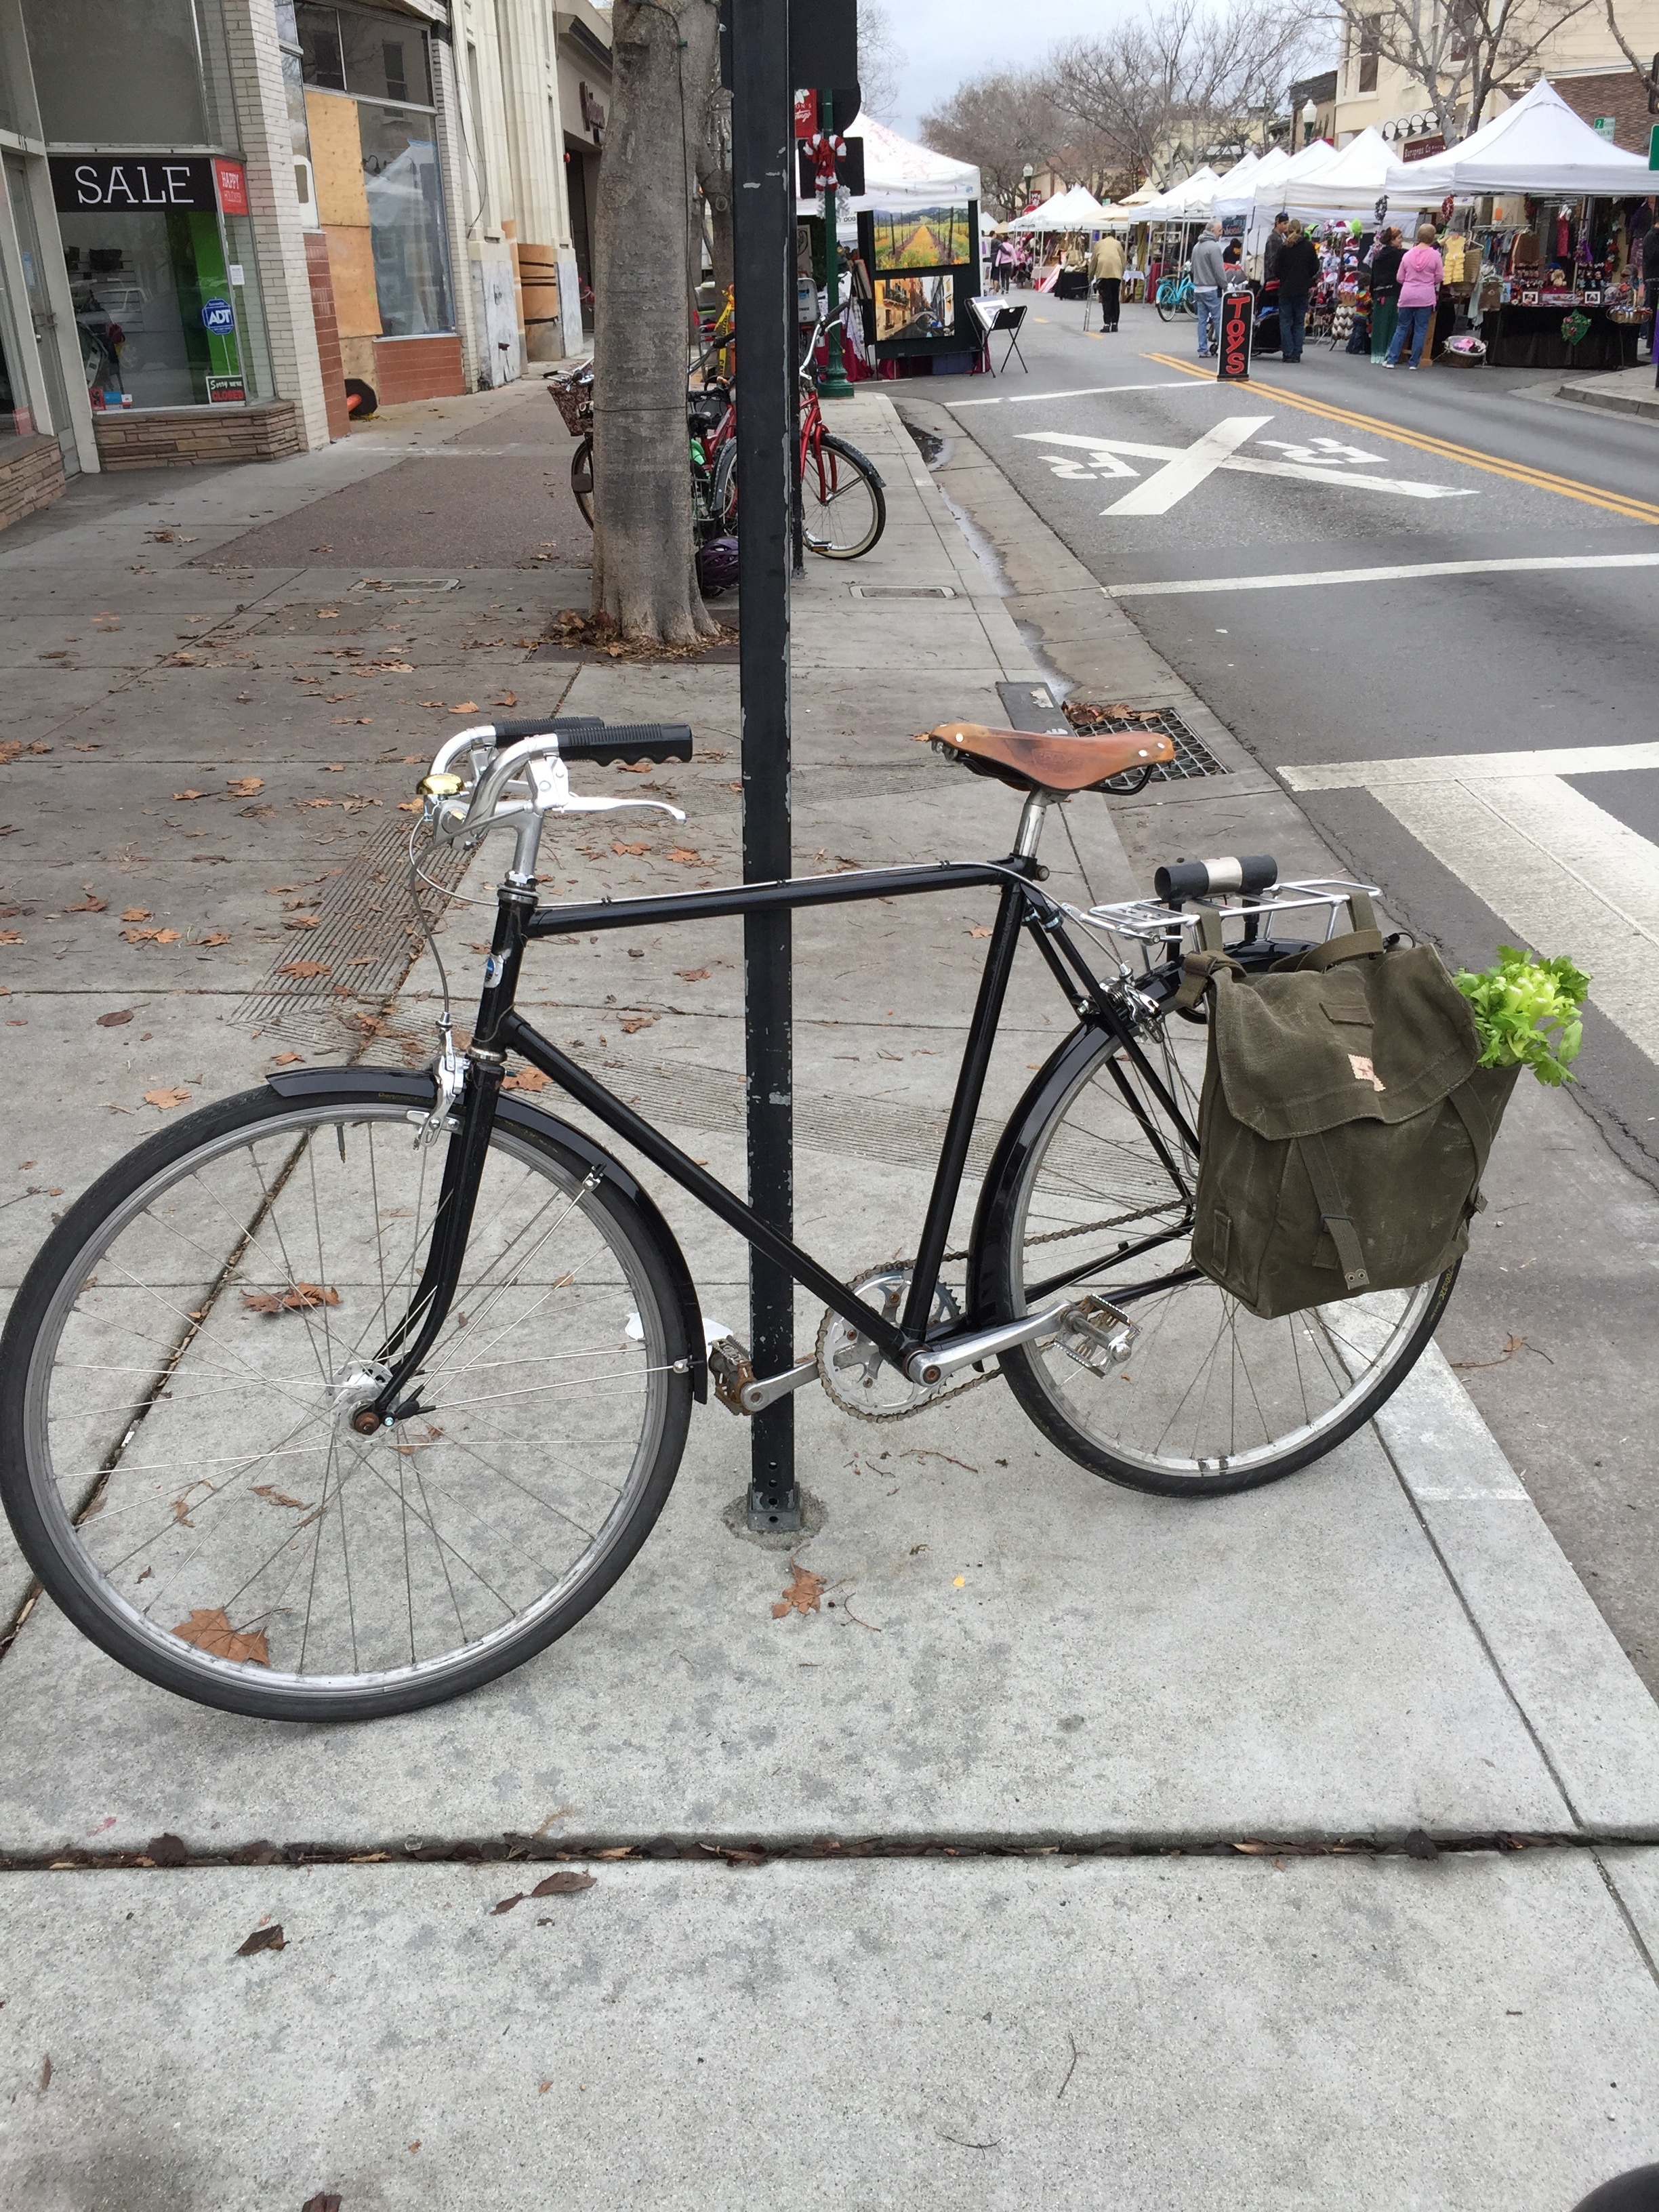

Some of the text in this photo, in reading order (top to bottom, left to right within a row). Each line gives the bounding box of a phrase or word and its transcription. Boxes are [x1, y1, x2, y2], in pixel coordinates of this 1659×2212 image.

[75, 165, 194, 204] SALE
[220, 171, 239, 190] HAPPY
[209, 309, 231, 325] ADT
[211, 389, 244, 401] CLOSED
